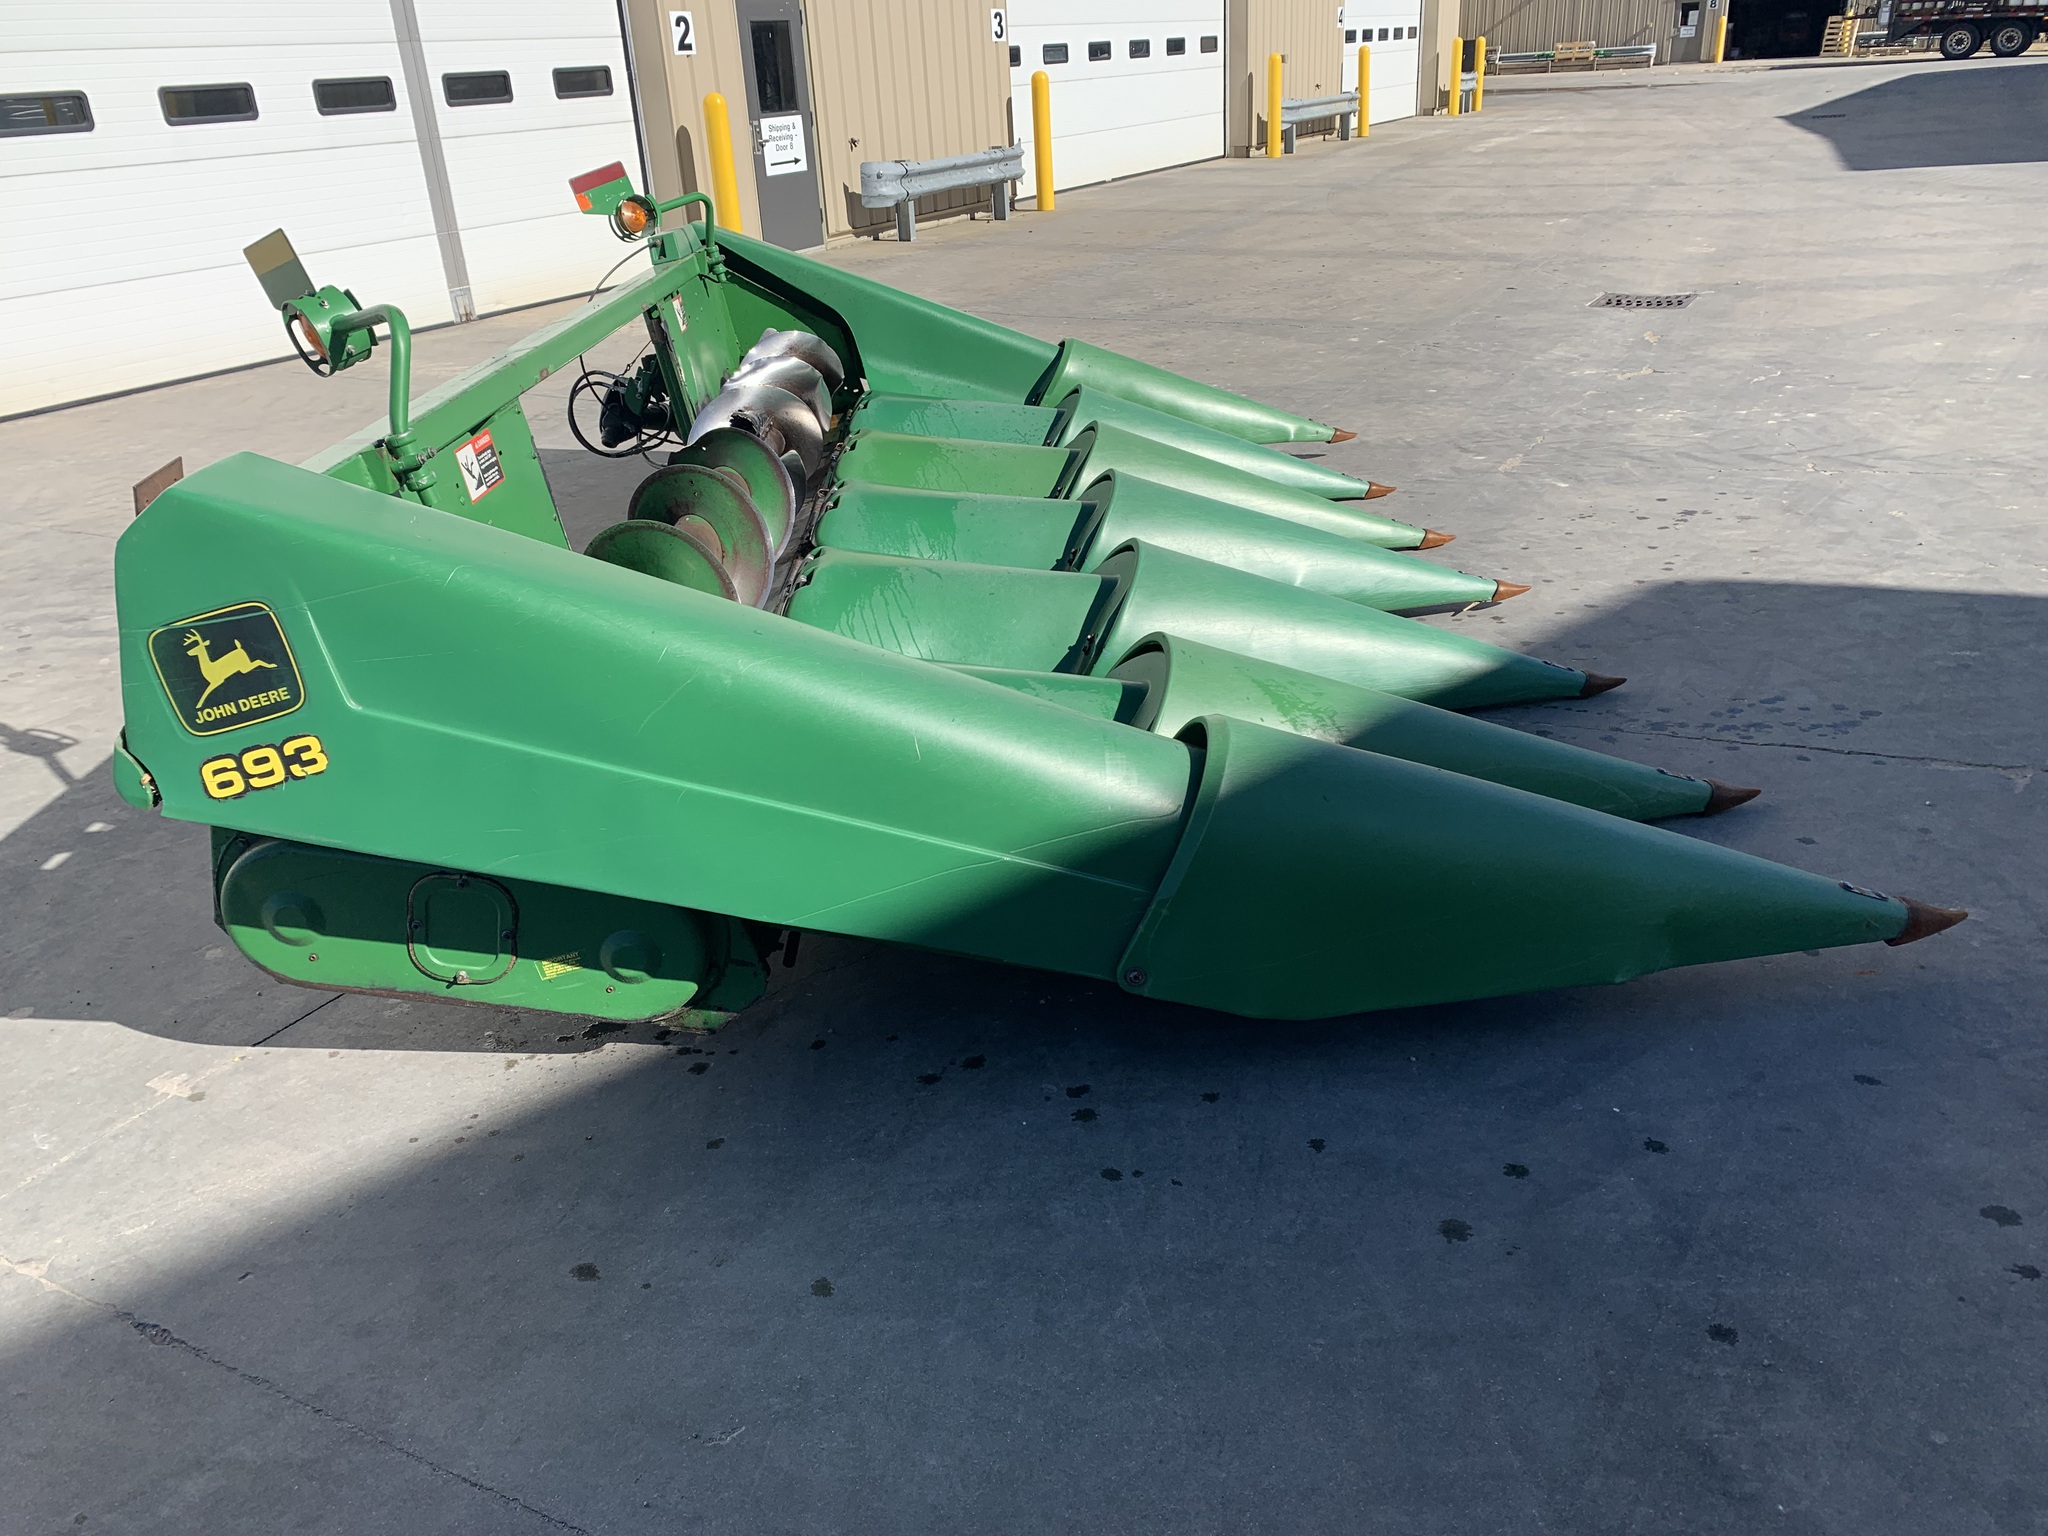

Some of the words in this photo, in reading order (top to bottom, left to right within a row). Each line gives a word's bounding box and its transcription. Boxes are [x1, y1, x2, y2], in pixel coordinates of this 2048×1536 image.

[1710, 0, 1717, 8] 8
[993, 11, 1003, 39] 3
[1338, 8, 1343, 26] 4
[675, 15, 693, 51] 2
[768, 123, 791, 133] Shipping
[792, 121, 796, 130] &
[768, 133, 793, 142] Receiving
[775, 143, 788, 152] Door
[789, 141, 794, 150] 8
[195, 702, 238, 724] JOHN
[237, 687, 291, 712] DEERE
[201, 735, 329, 799] 693
